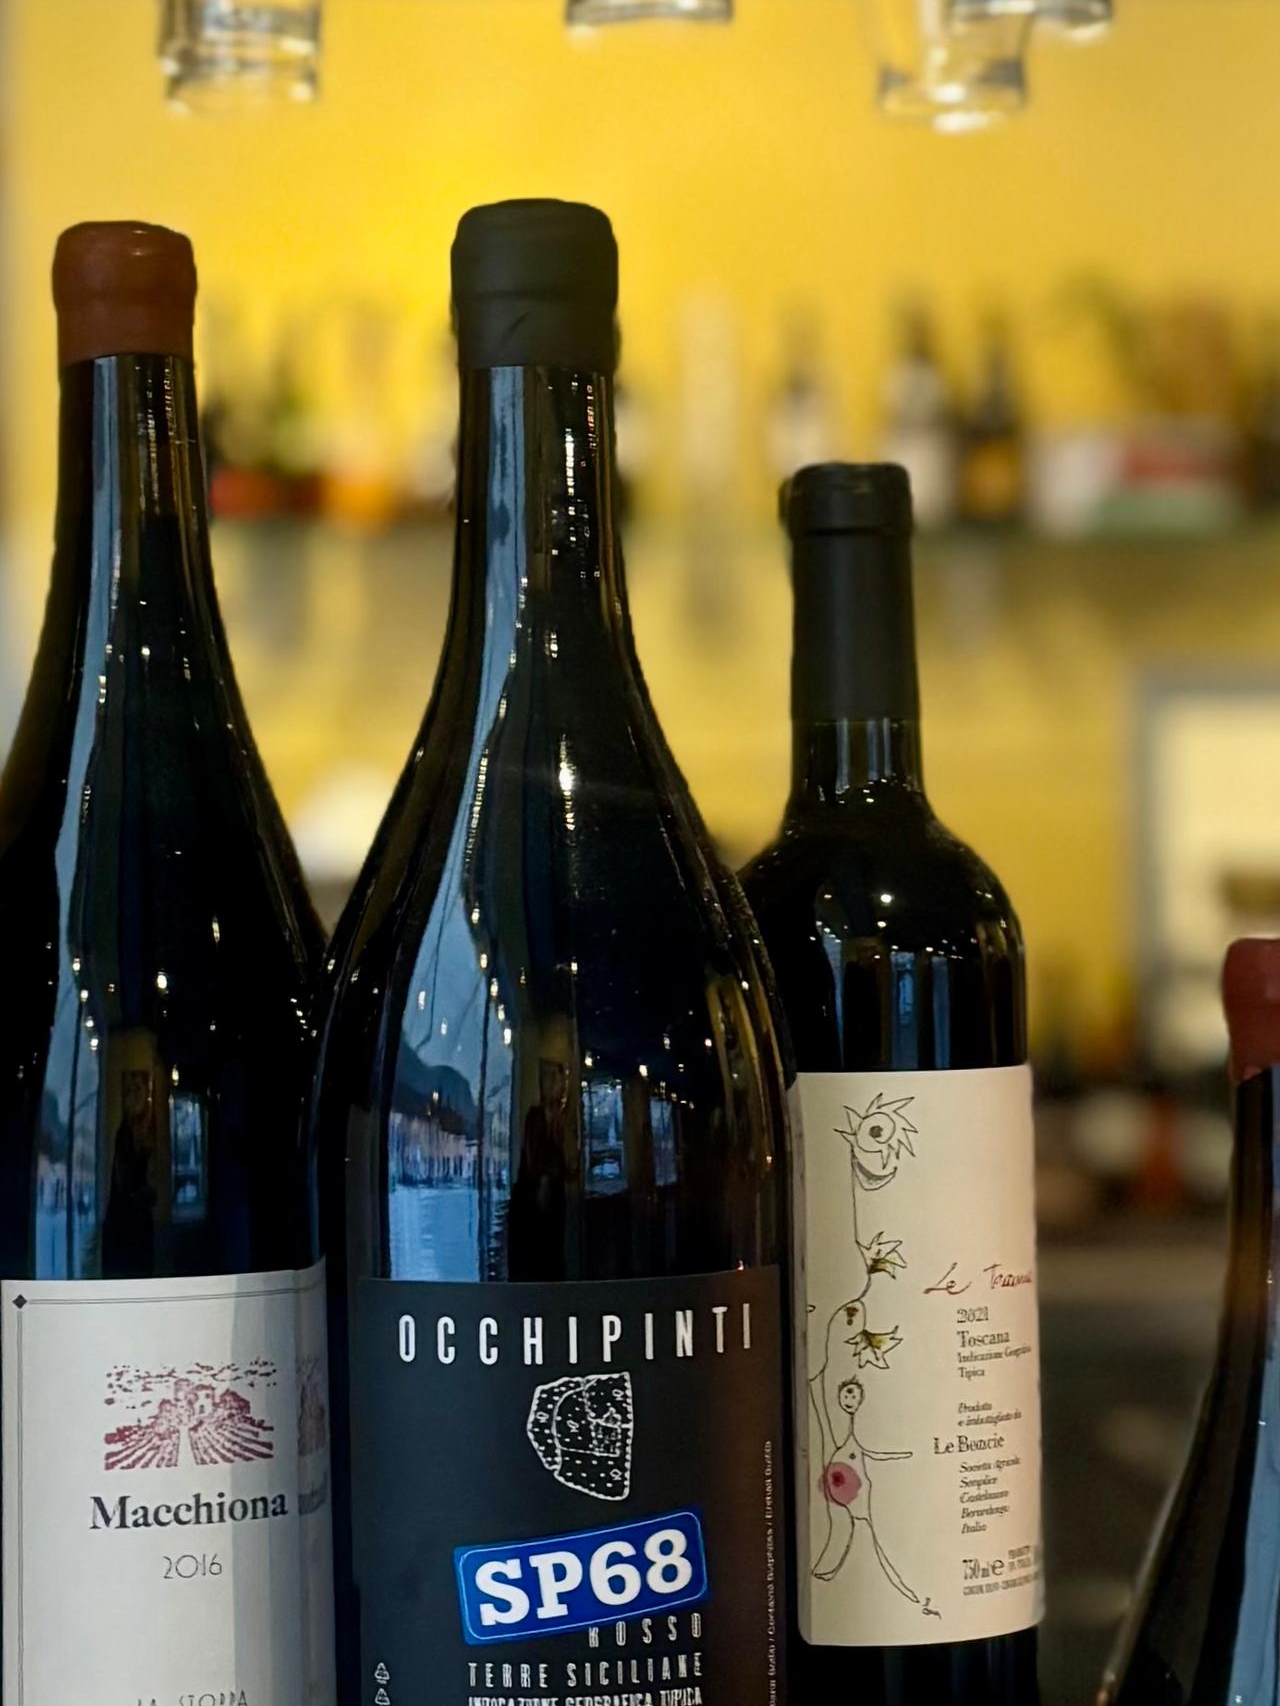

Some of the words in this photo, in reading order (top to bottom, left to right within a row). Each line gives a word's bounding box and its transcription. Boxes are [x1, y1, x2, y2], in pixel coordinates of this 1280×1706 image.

[923, 1262, 972, 1294] Le
[398, 1303, 751, 1365] OCCHIPINTI
[957, 1330, 1010, 1348] Toscana
[933, 1437, 955, 1454] Le
[957, 1432, 1006, 1454] Boncie
[89, 1492, 289, 1530] Macchiona
[163, 1553, 224, 1581] 2016
[475, 1528, 694, 1626] SP68
[588, 1612, 702, 1648] ROSSO
[468, 1662, 549, 1688] TERRE
[567, 1652, 703, 1687] SICILIANE
